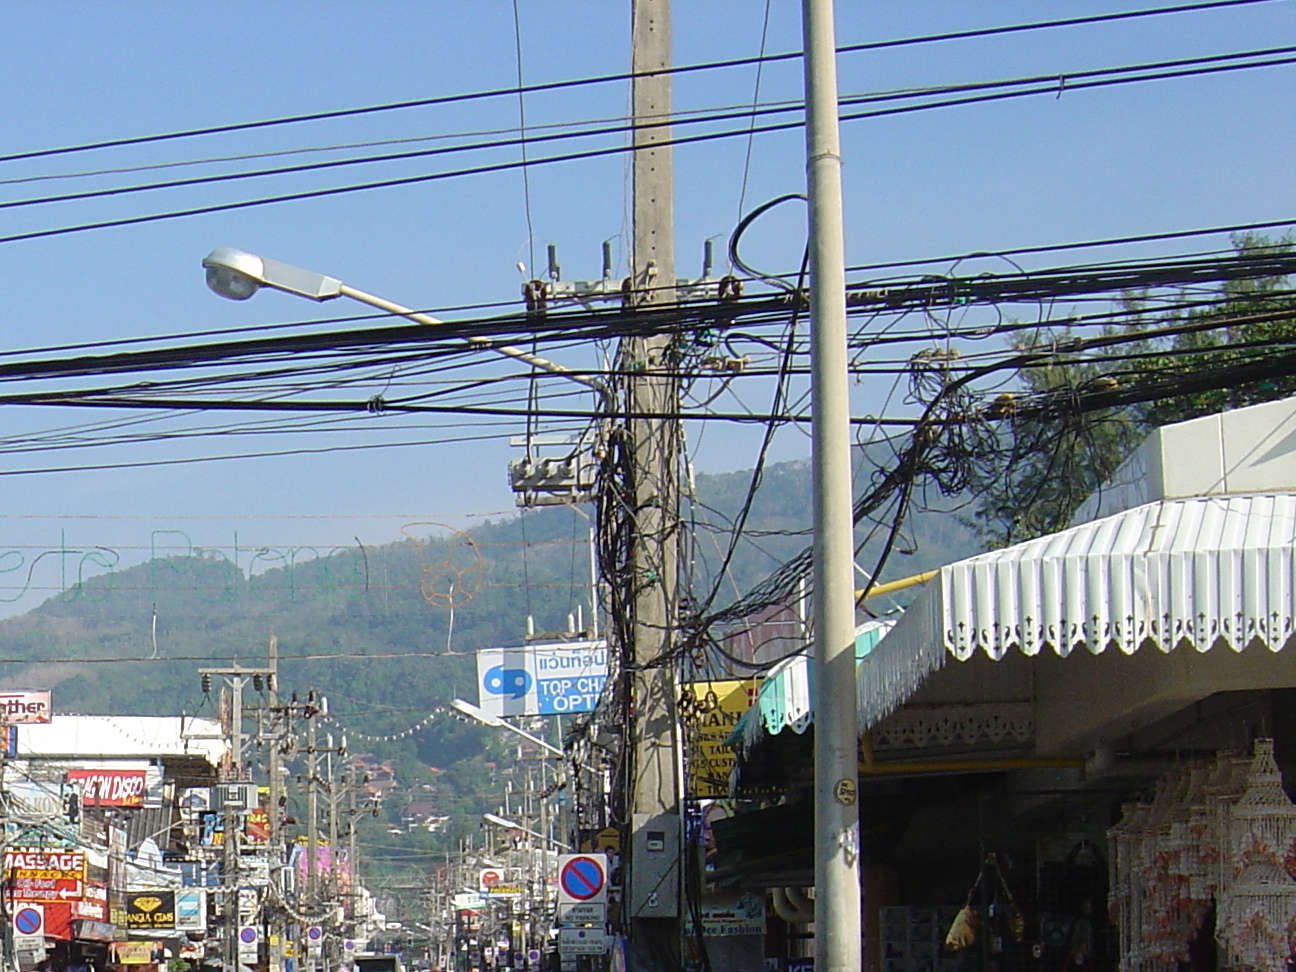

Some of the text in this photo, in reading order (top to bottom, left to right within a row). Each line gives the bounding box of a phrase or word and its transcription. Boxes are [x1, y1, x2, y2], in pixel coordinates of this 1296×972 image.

[540, 681, 571, 697] TOP
[69, 775, 143, 800] AGN DISCO
[5, 854, 84, 871] MASSAGE
